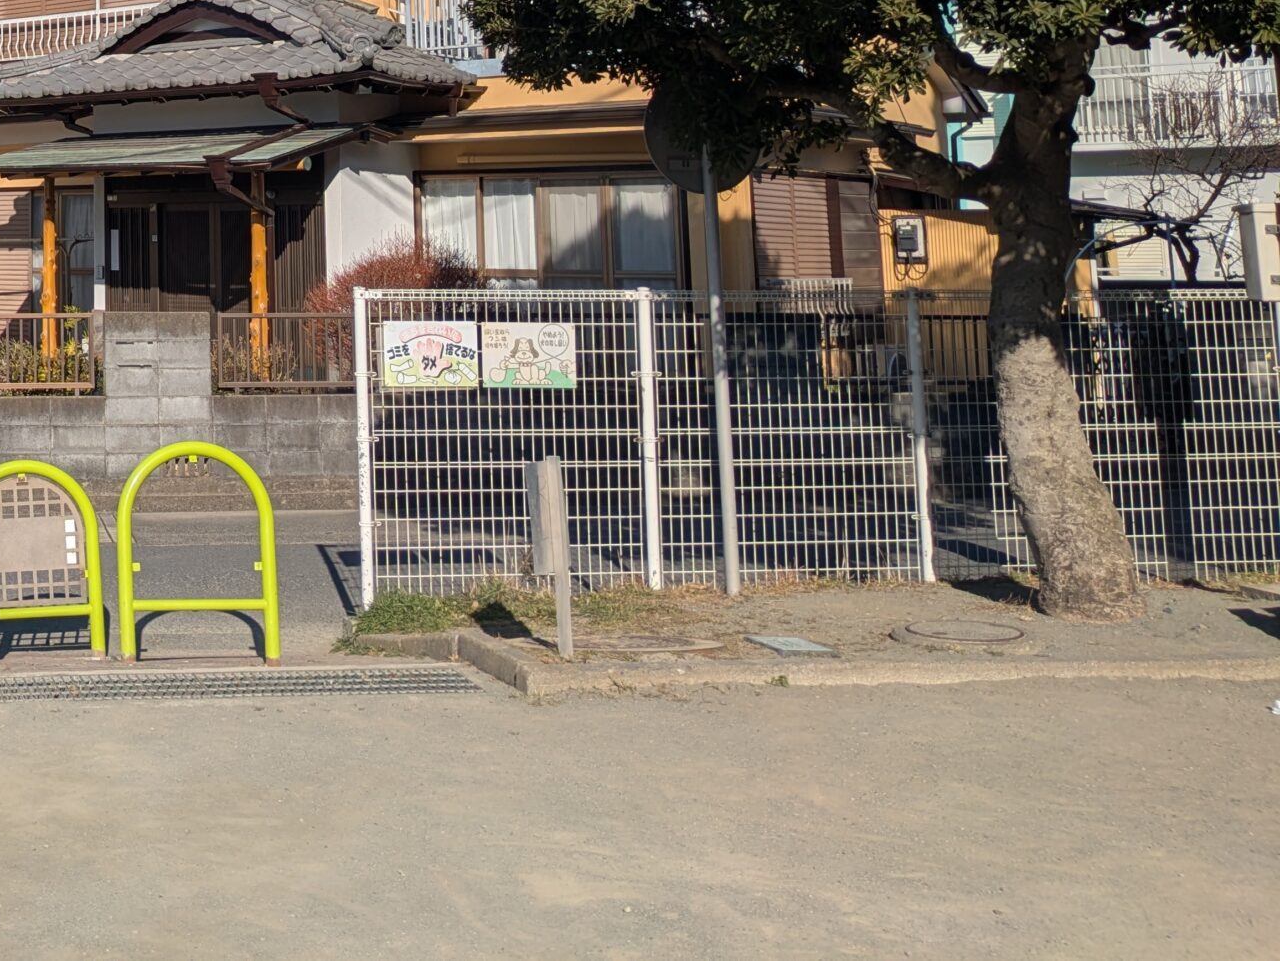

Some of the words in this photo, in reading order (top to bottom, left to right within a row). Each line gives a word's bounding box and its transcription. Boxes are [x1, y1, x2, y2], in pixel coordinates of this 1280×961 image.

[386, 343, 410, 360] ゴミを
[445, 343, 476, 360] 捨てるな
[421, 355, 437, 371] ダメ
